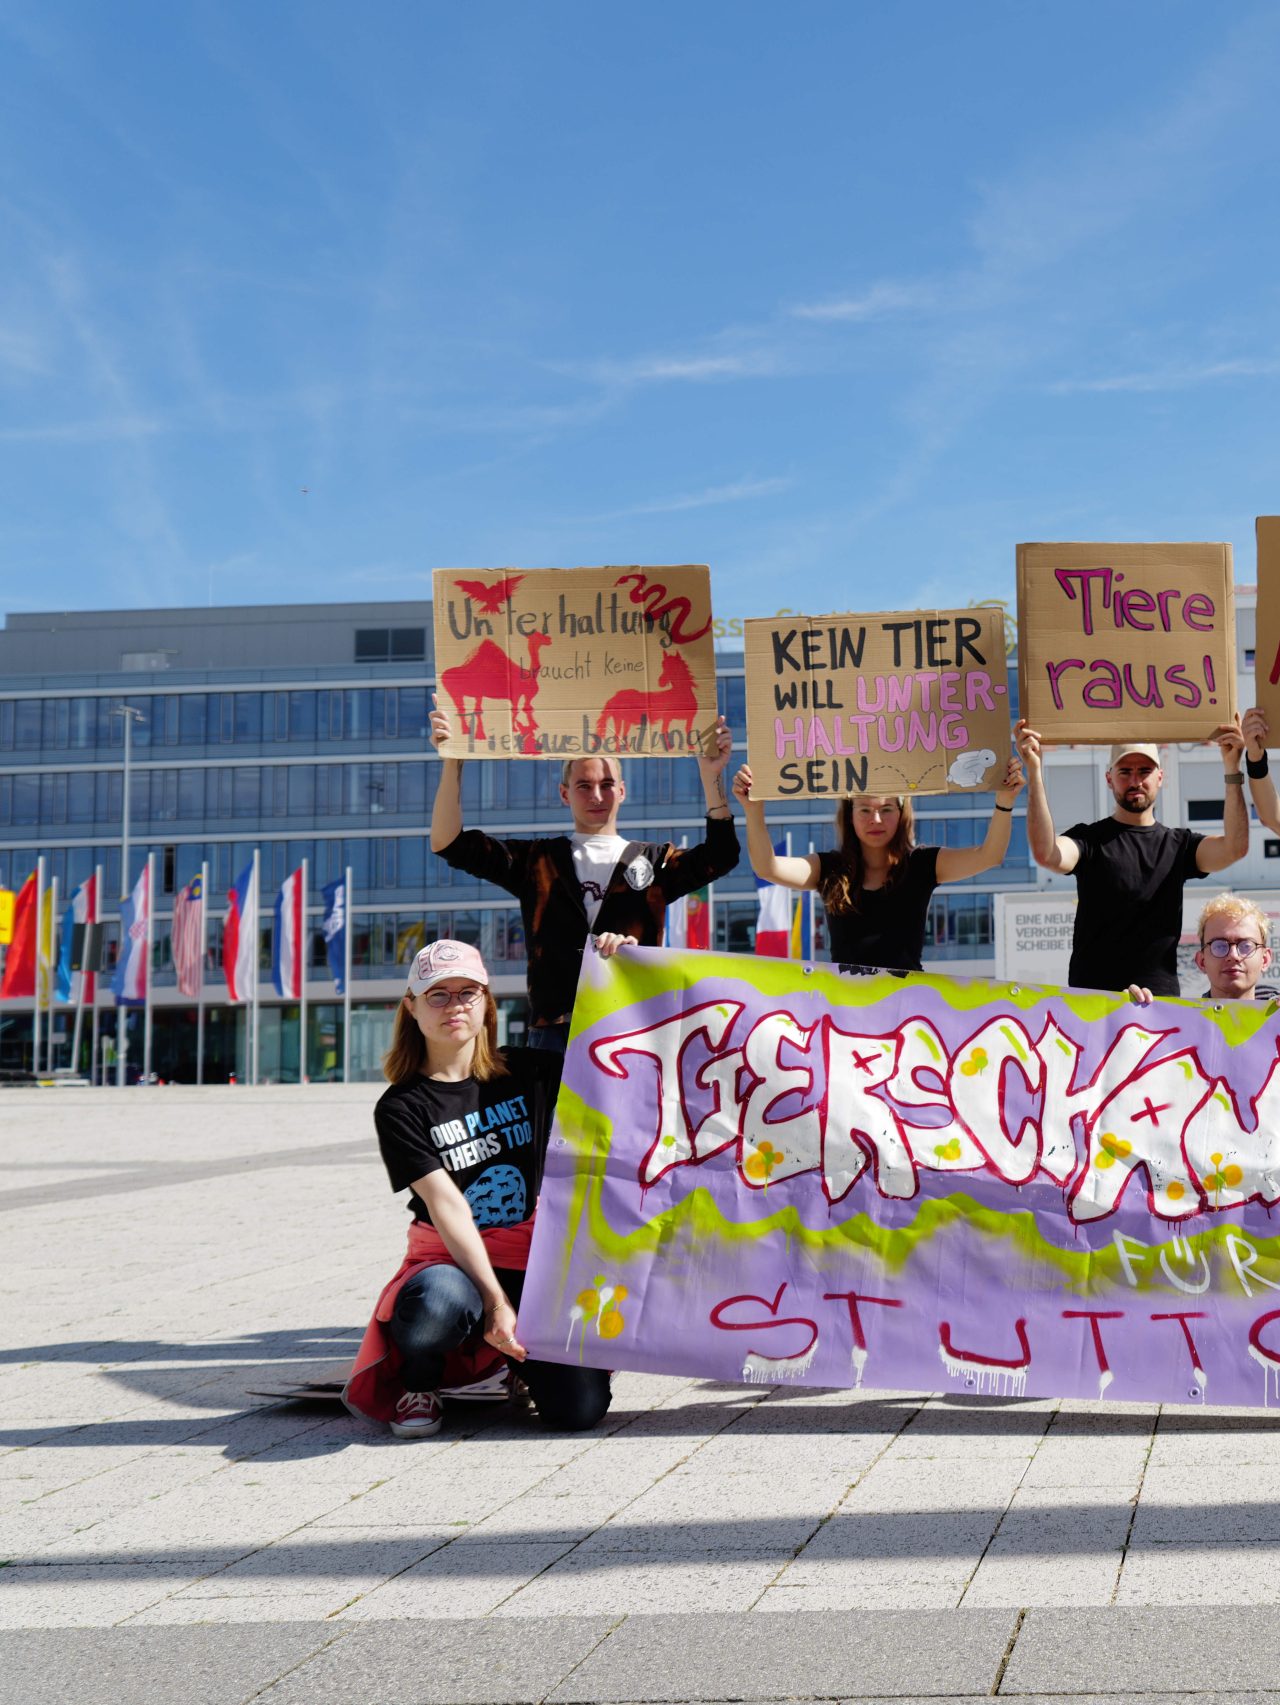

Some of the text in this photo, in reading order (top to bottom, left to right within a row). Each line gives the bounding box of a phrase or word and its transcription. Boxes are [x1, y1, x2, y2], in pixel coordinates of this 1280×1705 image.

[448, 591, 673, 648] Unterhaltung
[1055, 568, 1215, 635] Tiere
[519, 649, 591, 681] braucht
[772, 627, 866, 675] KEIN
[882, 617, 987, 669] TIER
[774, 671, 1008, 713] WILL UNTER-
[1046, 655, 1218, 710] raus!
[774, 711, 970, 759] HALTUNG
[777, 756, 868, 794] SEIN
[1016, 914, 1041, 925] EINE
[1016, 939, 1064, 951] SCHEIBE
[430, 1095, 528, 1149] OUR PLANET
[439, 1132, 502, 1172] THEIRS
